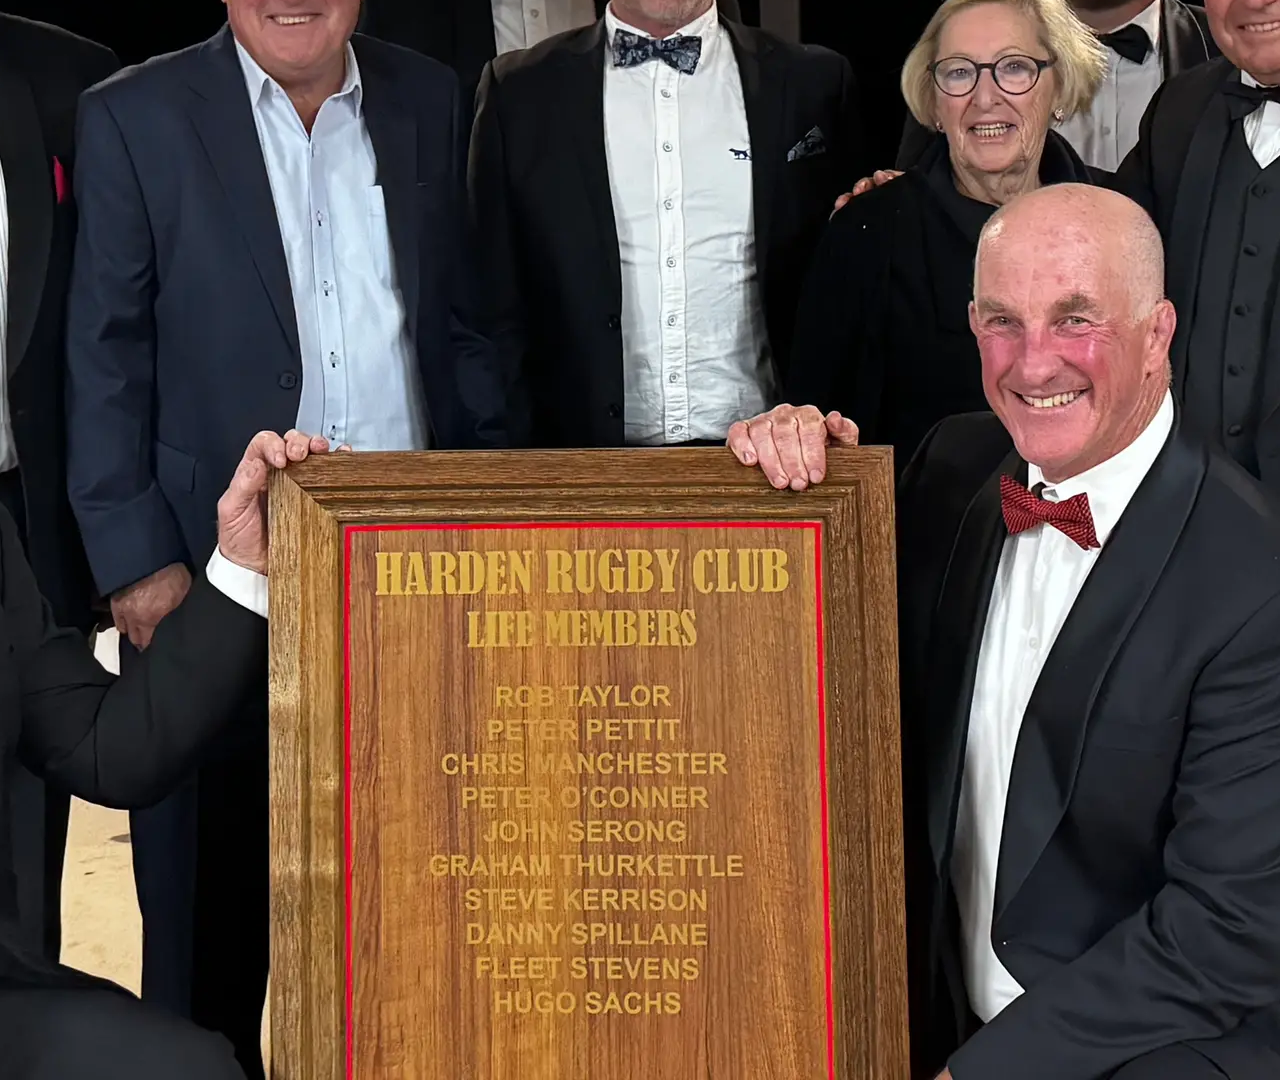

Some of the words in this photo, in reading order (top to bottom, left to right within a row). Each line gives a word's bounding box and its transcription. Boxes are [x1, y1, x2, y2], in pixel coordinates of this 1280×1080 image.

[375, 551, 533, 596] HARDEN
[547, 549, 680, 593] RUGBY
[693, 548, 789, 593] CLUB
[467, 611, 534, 648] LIFE
[545, 609, 697, 647] MEMBERS
[496, 685, 554, 707] ROB
[563, 685, 671, 707] TAYLOR
[488, 720, 578, 742] PETER
[586, 719, 680, 741] PETTIT
[441, 753, 525, 776] CHRIS
[533, 753, 727, 775] MANCHESTER
[462, 787, 552, 809] PETER
[483, 821, 559, 844] JOHN
[567, 821, 687, 843] SERONG
[429, 855, 552, 878] GRAHAM
[559, 855, 744, 877] THURKETTLE
[465, 889, 554, 912] STEVE
[563, 889, 708, 912] KERRISON
[466, 924, 562, 946] DANNY
[570, 923, 708, 946] SPILLANE
[476, 958, 561, 980] FLEET
[569, 958, 700, 980] STEVENS
[495, 992, 576, 1015] HUGO
[585, 992, 681, 1015] SACHS
